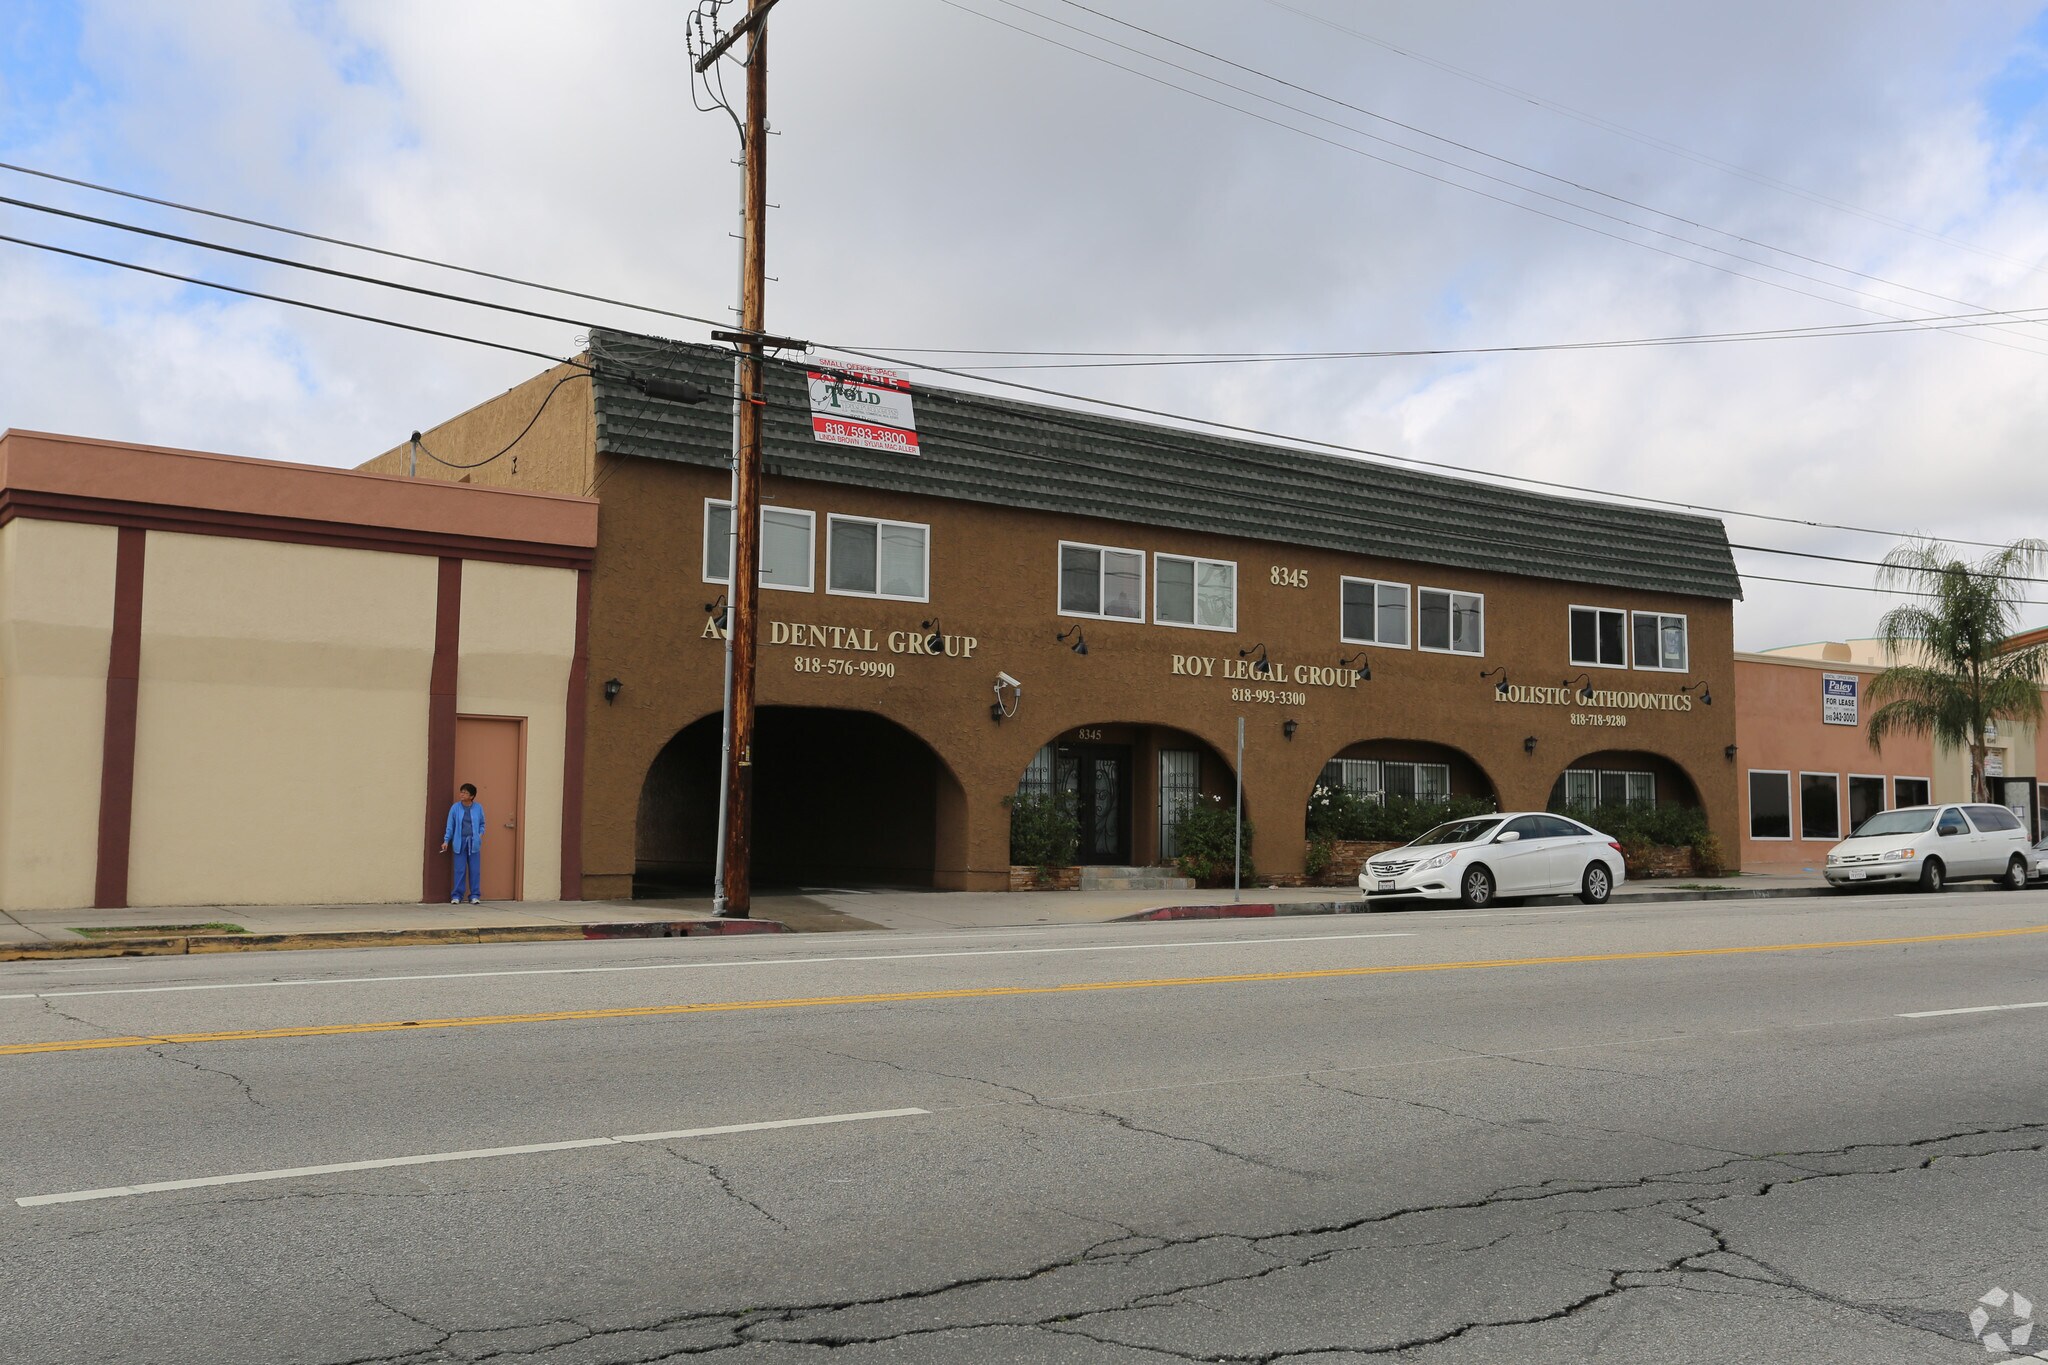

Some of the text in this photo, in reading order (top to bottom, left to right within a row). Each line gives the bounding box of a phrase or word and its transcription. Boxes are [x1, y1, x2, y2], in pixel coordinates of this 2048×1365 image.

[819, 359, 897, 377] SMALL OFFICE SPACE
[819, 433, 836, 441] LINDA
[838, 435, 860, 445] BROWN
[864, 440, 883, 449] SYLVIA
[825, 422, 907, 444] 818/593-3800
[1270, 565, 1309, 588] 8345
[770, 621, 879, 651] DENTAL
[887, 631, 978, 658] GROUP
[794, 656, 895, 678] 818-576-9990
[1171, 654, 1362, 688] ROY LEGAL GROUP
[1231, 687, 1306, 706] 818-993-3300
[1829, 680, 1852, 693] Paley
[1494, 684, 1692, 711] HOLISTIC ORTHODONTICS
[1570, 713, 1627, 727] 818-718-9280
[1078, 728, 1102, 740] 8345
